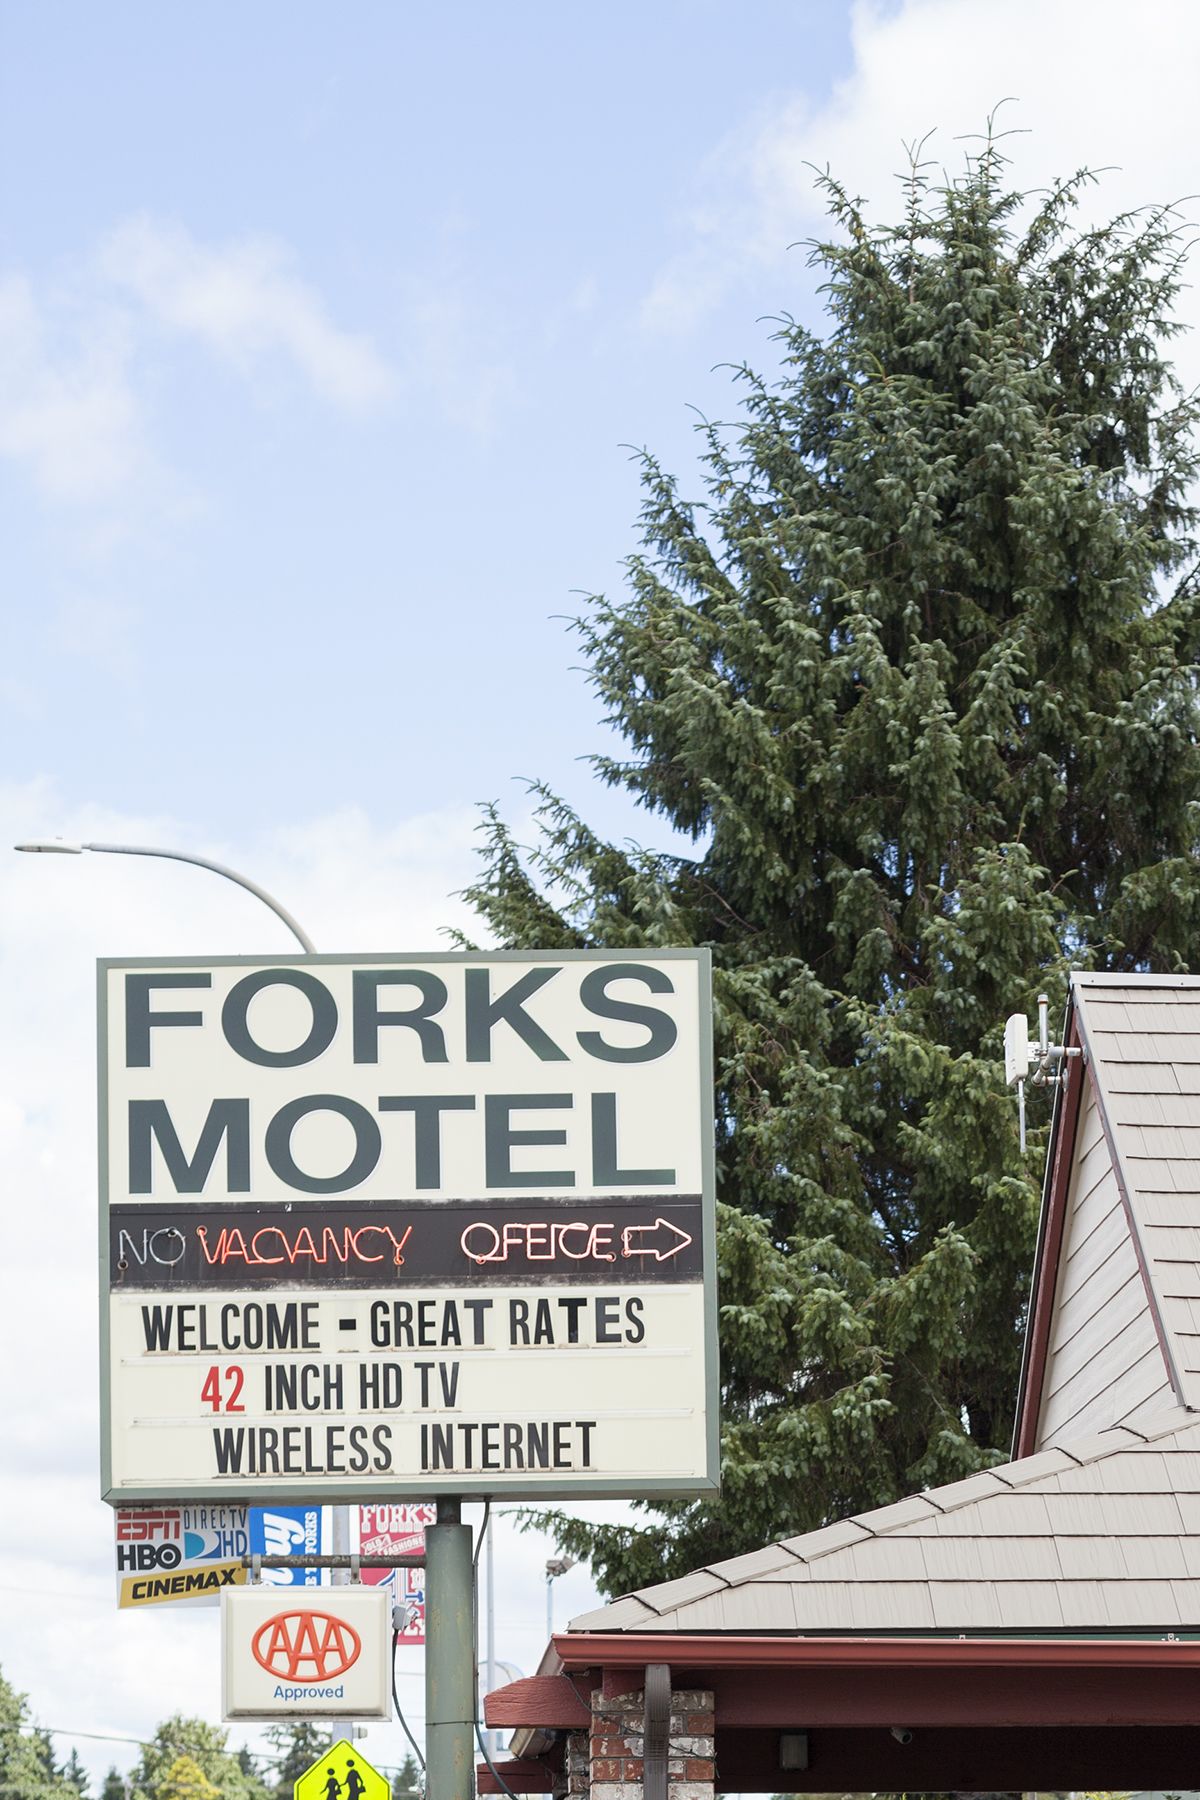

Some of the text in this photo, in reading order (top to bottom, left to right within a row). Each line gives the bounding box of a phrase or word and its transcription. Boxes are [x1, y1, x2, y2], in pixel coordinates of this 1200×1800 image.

[125, 963, 678, 1068] FORKS
[127, 1092, 677, 1195] MOTEL
[119, 1226, 412, 1264] NO VACANCY
[460, 1222, 615, 1261] OFFICE
[140, 1302, 321, 1351] WELCOME
[369, 1299, 494, 1349] GREAT
[509, 1297, 646, 1346] RATES
[199, 1365, 246, 1412] 42
[264, 1363, 344, 1411] INCH
[212, 1420, 598, 1475] WIRELESS INTERNET
[117, 1509, 180, 1540] ESPN
[184, 1508, 247, 1530] DIRECTV
[361, 1503, 437, 1532] FORKS
[117, 1543, 182, 1571] HBO
[221, 1530, 248, 1557] HD
[131, 1567, 238, 1600] CINEMAX
[262, 1610, 350, 1680] AAA
[273, 1685, 344, 1701] Approved
